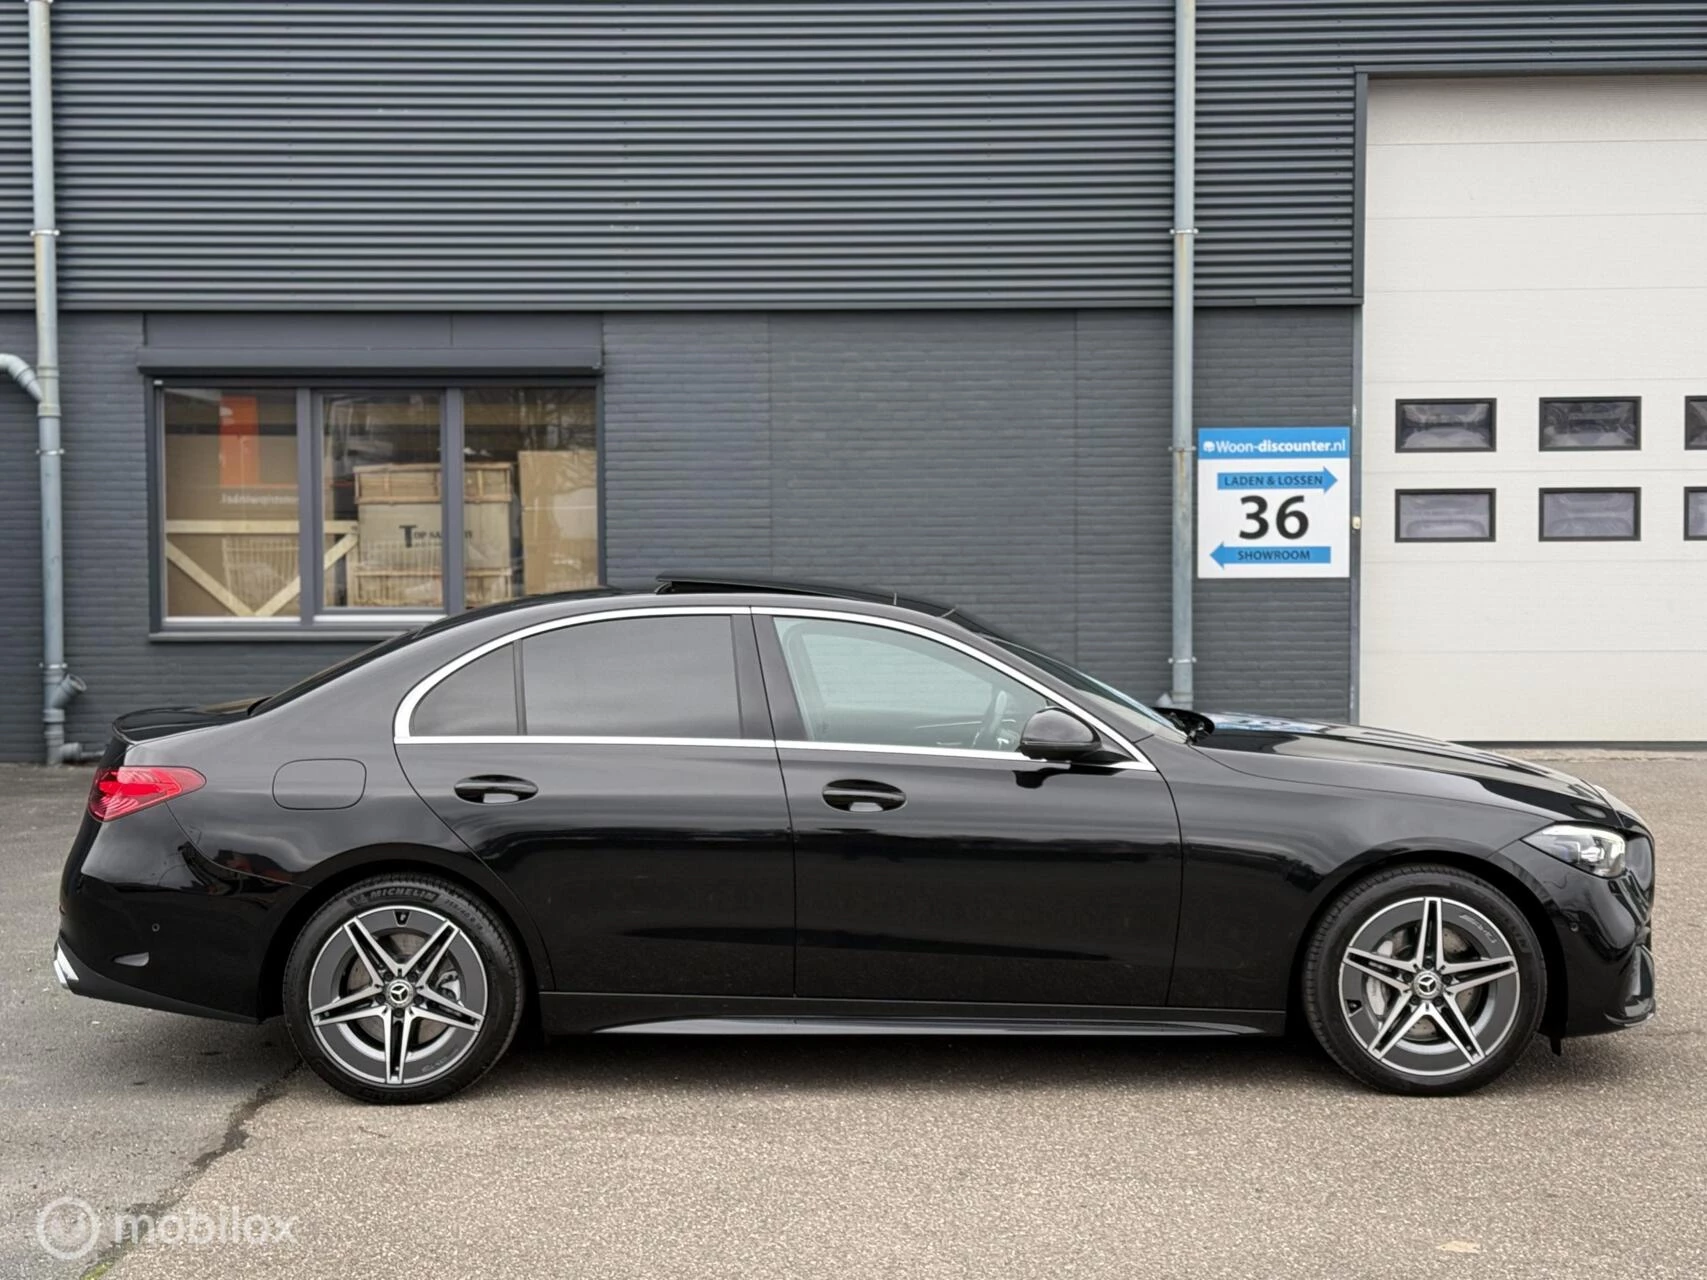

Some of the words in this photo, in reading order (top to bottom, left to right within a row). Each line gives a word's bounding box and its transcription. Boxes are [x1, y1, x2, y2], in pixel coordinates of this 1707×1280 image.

[1216, 439, 1346, 453] Woon-discounter.nl
[1224, 476, 1264, 487] LADEN
[1266, 476, 1276, 486] &
[1278, 475, 1323, 486] LOSSEN
[1239, 495, 1309, 540] 36
[1237, 550, 1311, 561] SHOWROOM
[370, 887, 437, 902] MICHELIN
